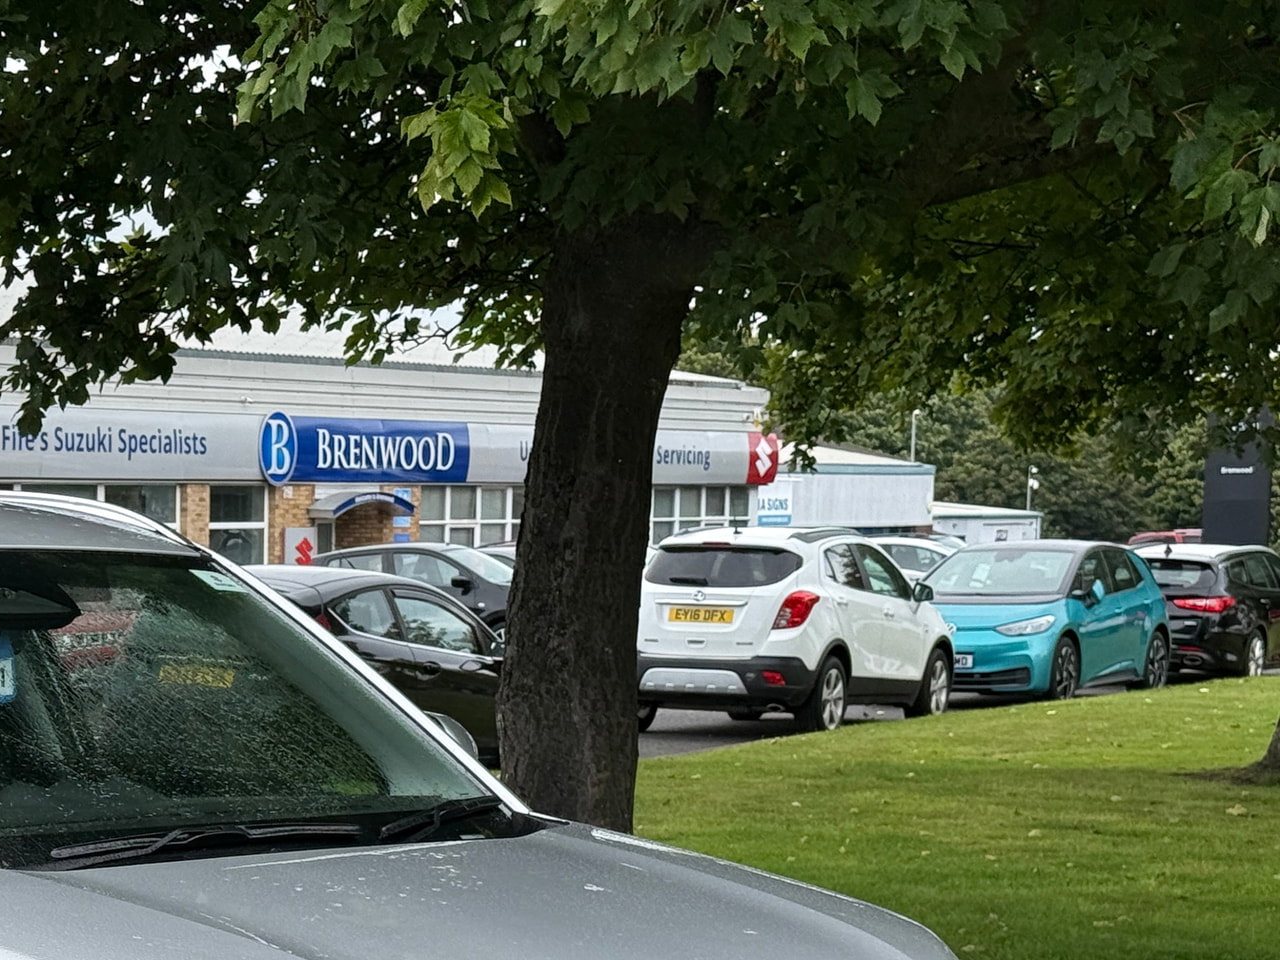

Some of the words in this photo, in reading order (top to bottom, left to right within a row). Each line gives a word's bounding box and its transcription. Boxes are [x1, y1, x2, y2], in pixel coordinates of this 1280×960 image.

[1, 424, 49, 451] Fies
[53, 426, 112, 453] Suzuki
[118, 428, 207, 461] Specialists
[316, 428, 455, 472] BRENWOOD
[656, 444, 711, 471] Servicing
[767, 498, 789, 511] SIGNS
[675, 608, 700, 621] EY16
[703, 609, 727, 622] DFX
